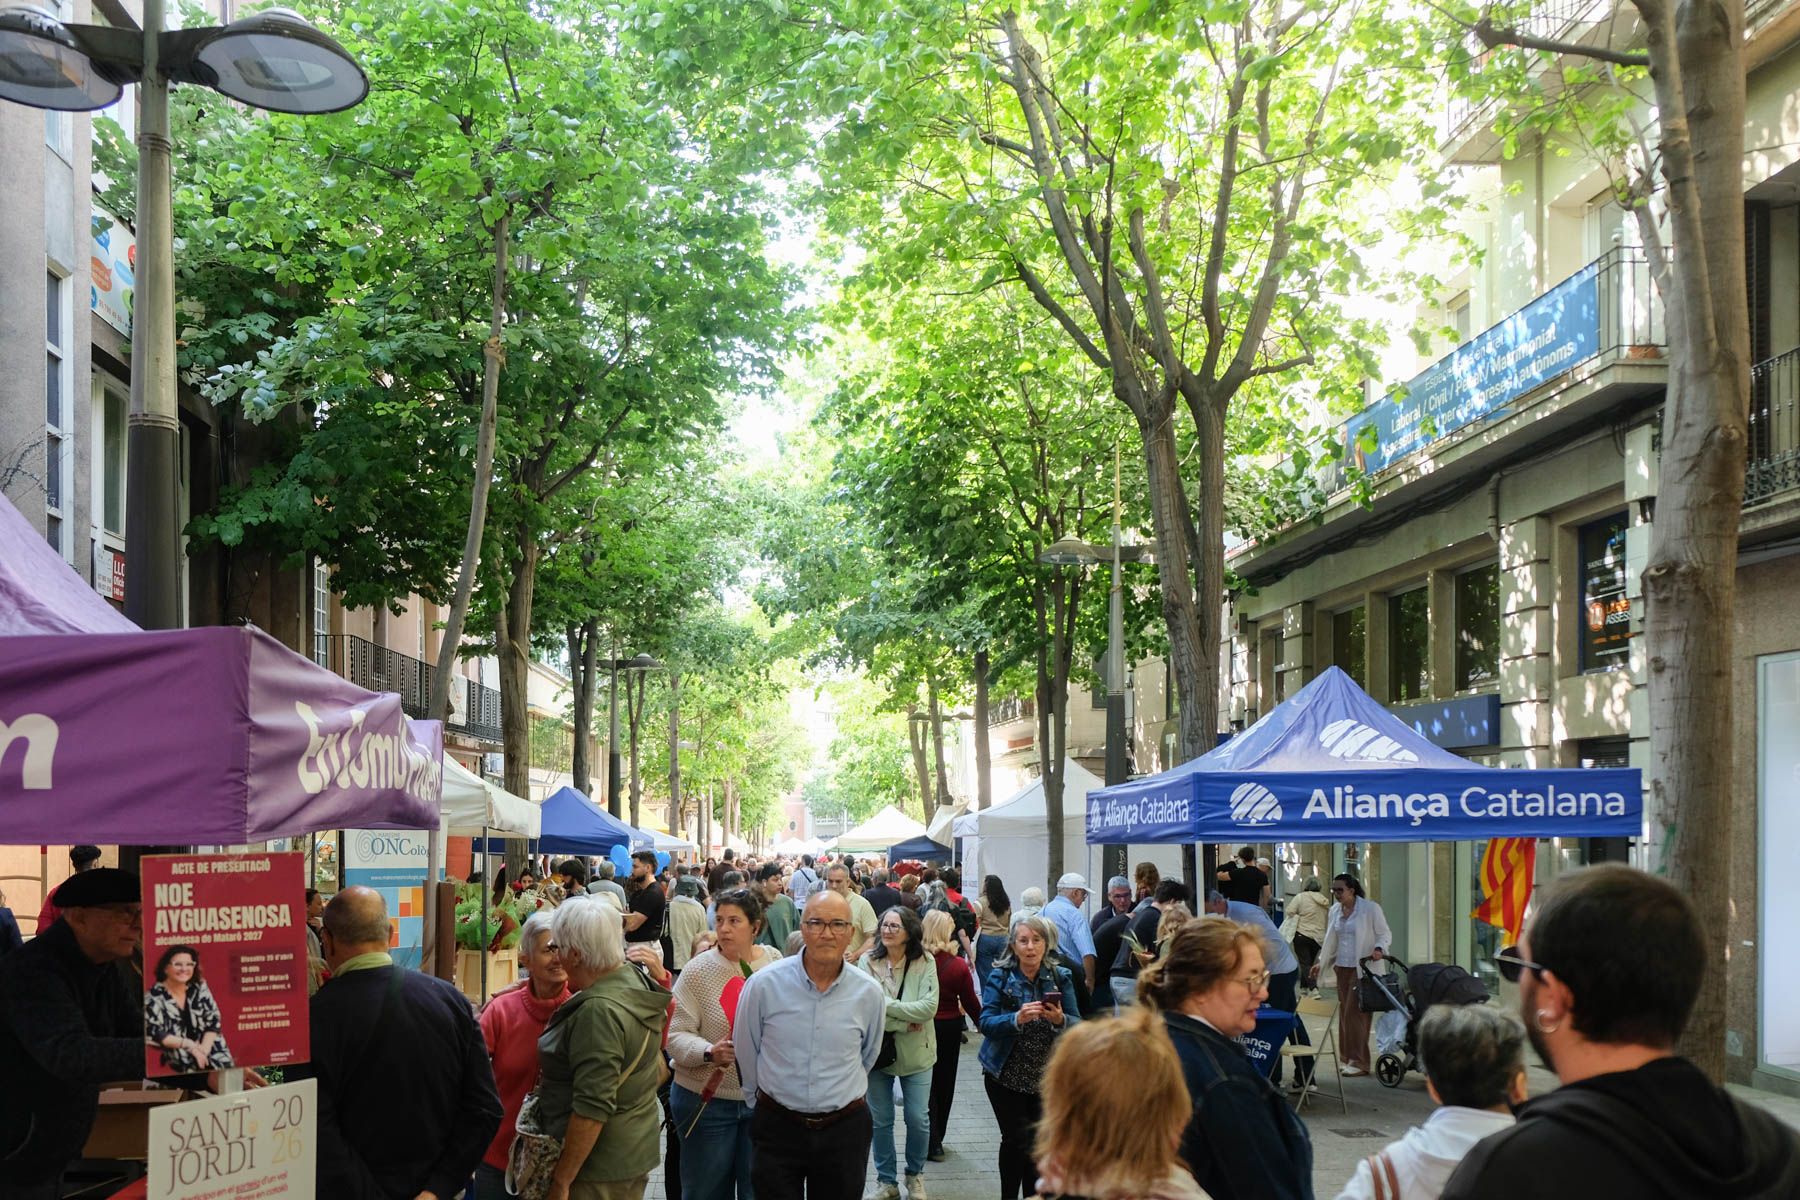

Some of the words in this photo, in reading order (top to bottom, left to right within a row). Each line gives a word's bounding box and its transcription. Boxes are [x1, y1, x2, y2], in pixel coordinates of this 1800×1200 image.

[1392, 407, 1421, 434] Laboral
[1428, 391, 1448, 413] Civil
[1104, 798, 1138, 832] Aliança
[1140, 793, 1189, 824] Catalana
[1302, 786, 1449, 826] Aliança
[1460, 784, 1625, 817] Catalana
[172, 862, 194, 875] ACTE
[197, 862, 209, 874] DE
[211, 858, 271, 874] PRESENTACIÓ
[371, 838, 430, 857] ONColò
[154, 882, 194, 908] NOE
[155, 904, 292, 934] AYGUASENOSA
[155, 934, 200, 946] alcaldessa
[201, 933, 212, 944] de
[213, 931, 242, 943] Mataró
[244, 931, 263, 941] 2027
[168, 1105, 252, 1153] SANT
[272, 1094, 303, 1132] 20
[166, 1136, 256, 1195] JORDI
[272, 1128, 303, 1167] 26
